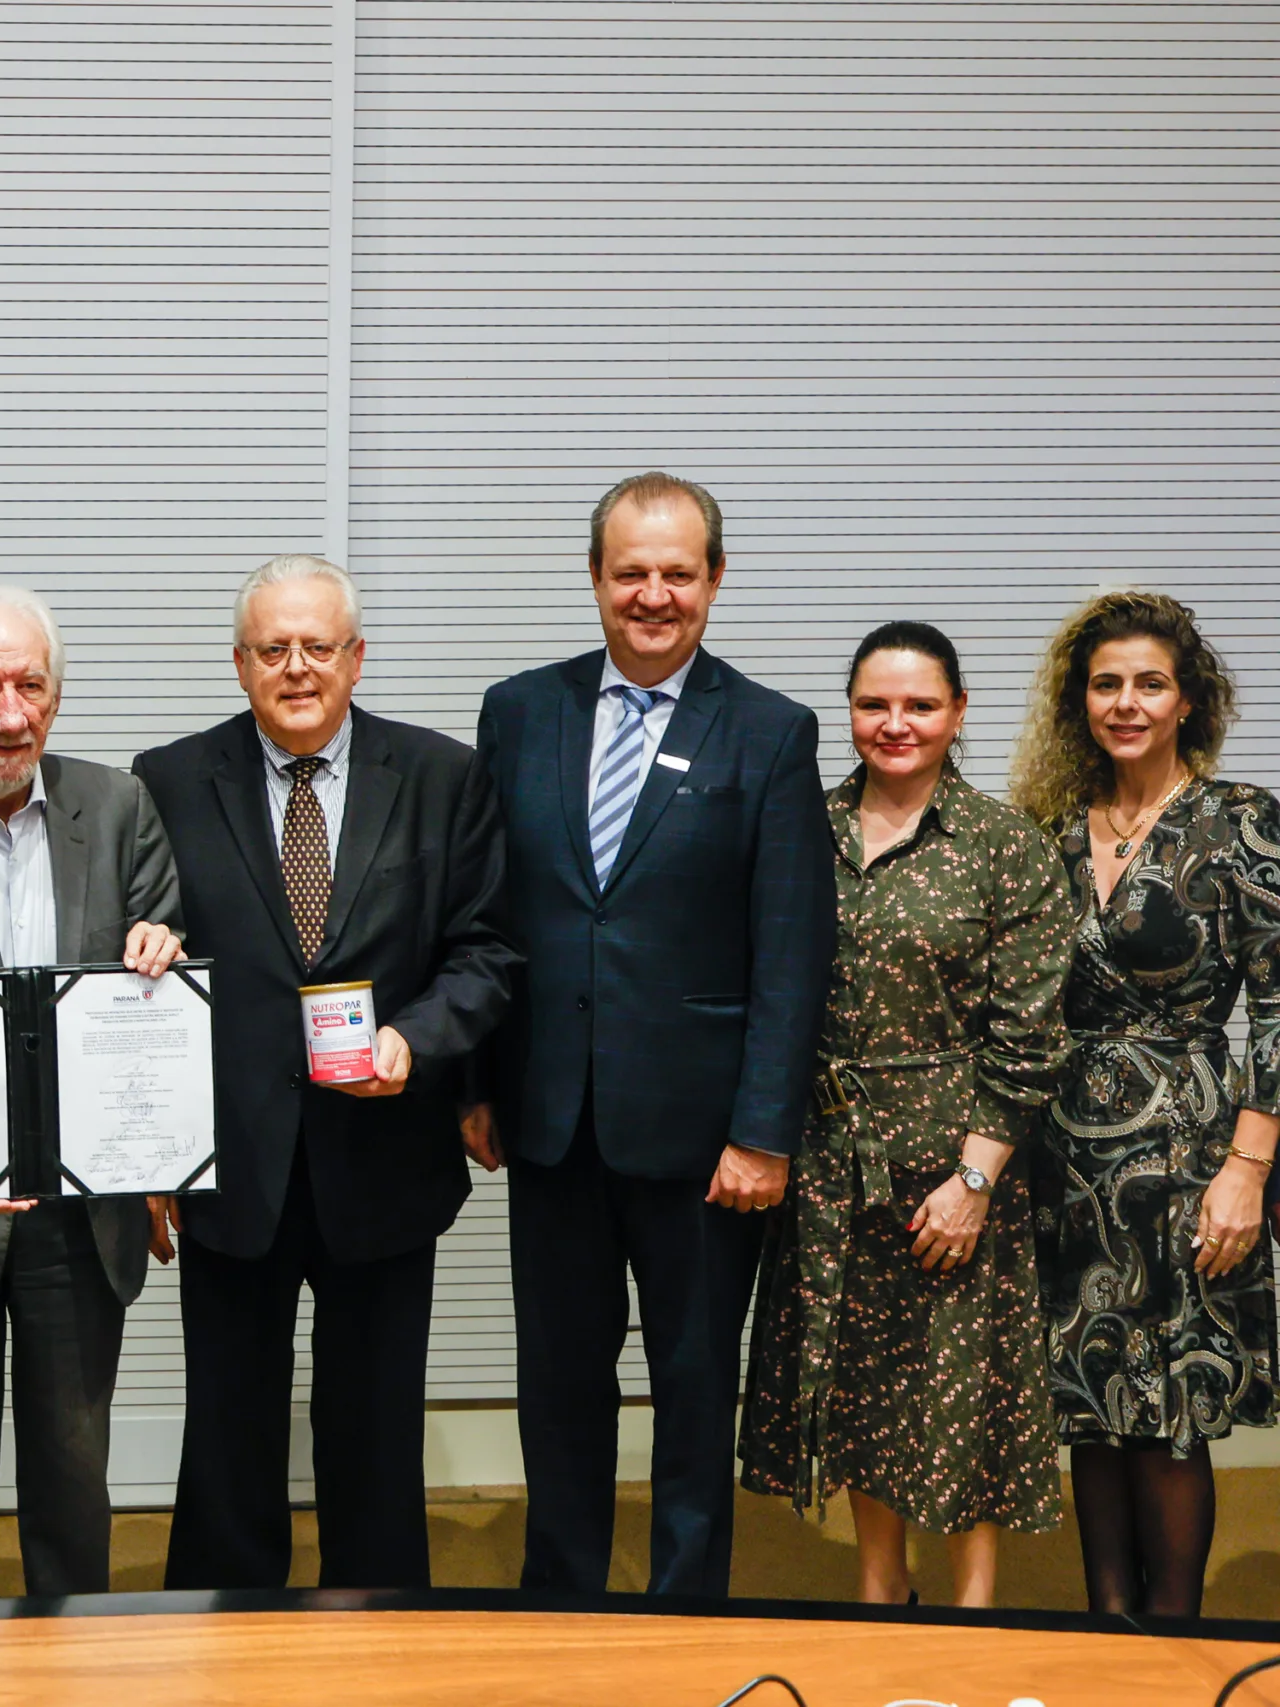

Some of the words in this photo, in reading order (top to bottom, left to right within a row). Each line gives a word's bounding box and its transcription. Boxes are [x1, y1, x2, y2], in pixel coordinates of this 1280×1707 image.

[113, 994, 140, 1002] PARANÁ
[310, 1000, 361, 1013] NUTROPAR
[316, 1017, 343, 1026] Amino
